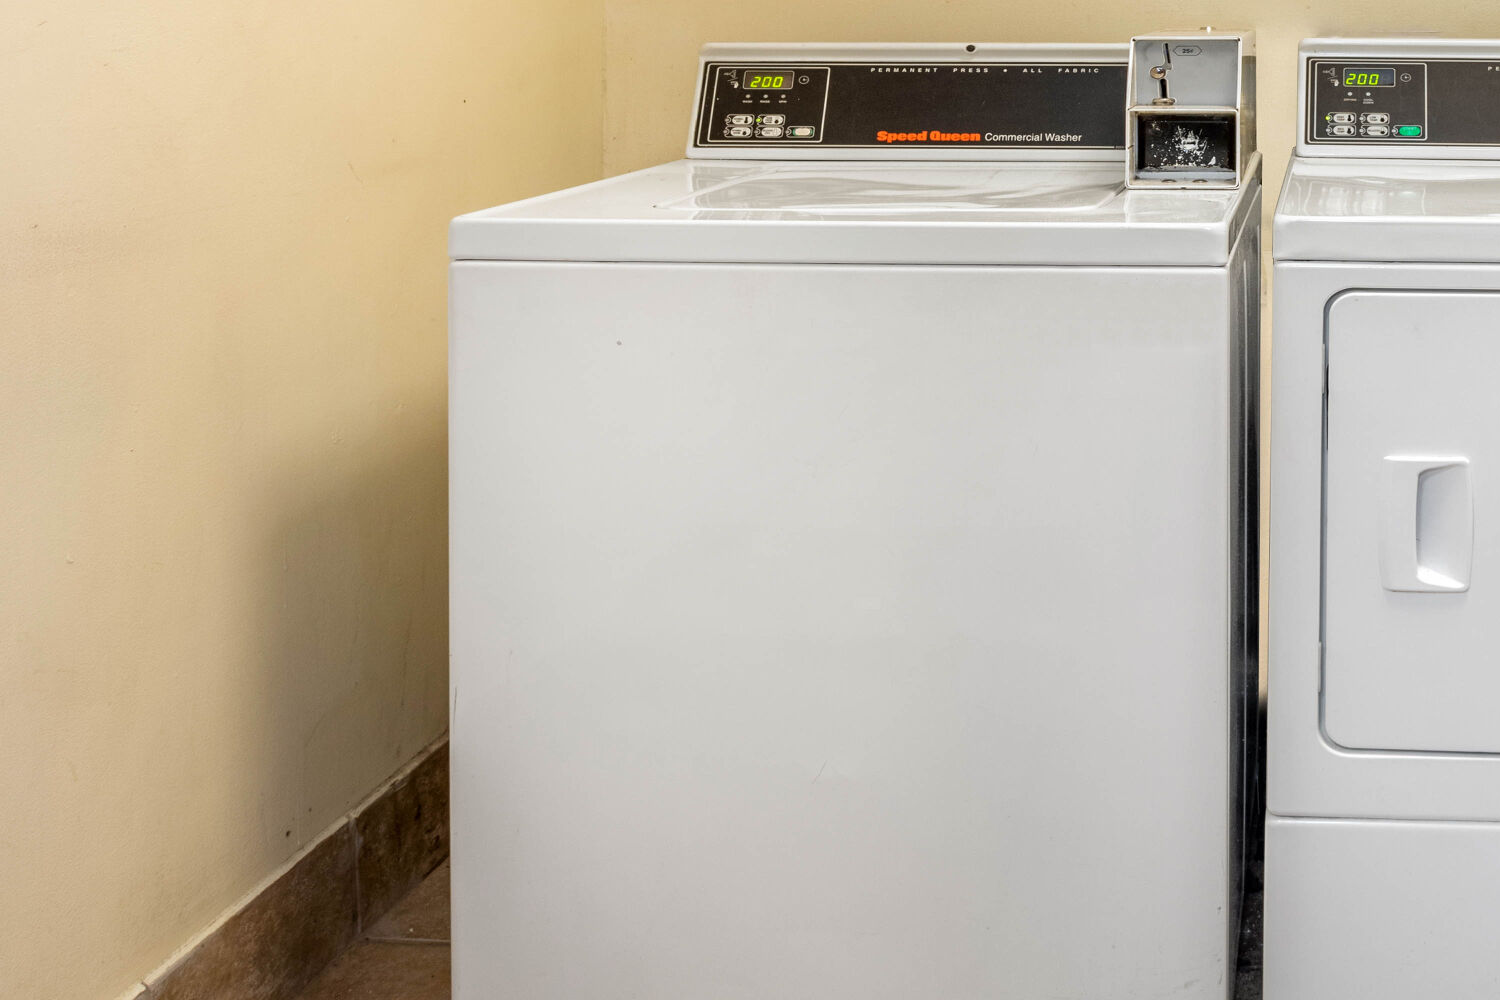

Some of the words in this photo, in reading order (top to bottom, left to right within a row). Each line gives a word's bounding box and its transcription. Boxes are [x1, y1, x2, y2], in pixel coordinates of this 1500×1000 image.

[750, 76, 784, 88] 200
[1346, 73, 1379, 85] 200
[877, 130, 927, 143] Speed
[929, 131, 981, 142] Queen
[985, 132, 1042, 142] Commercial
[1045, 132, 1082, 142] Washer
